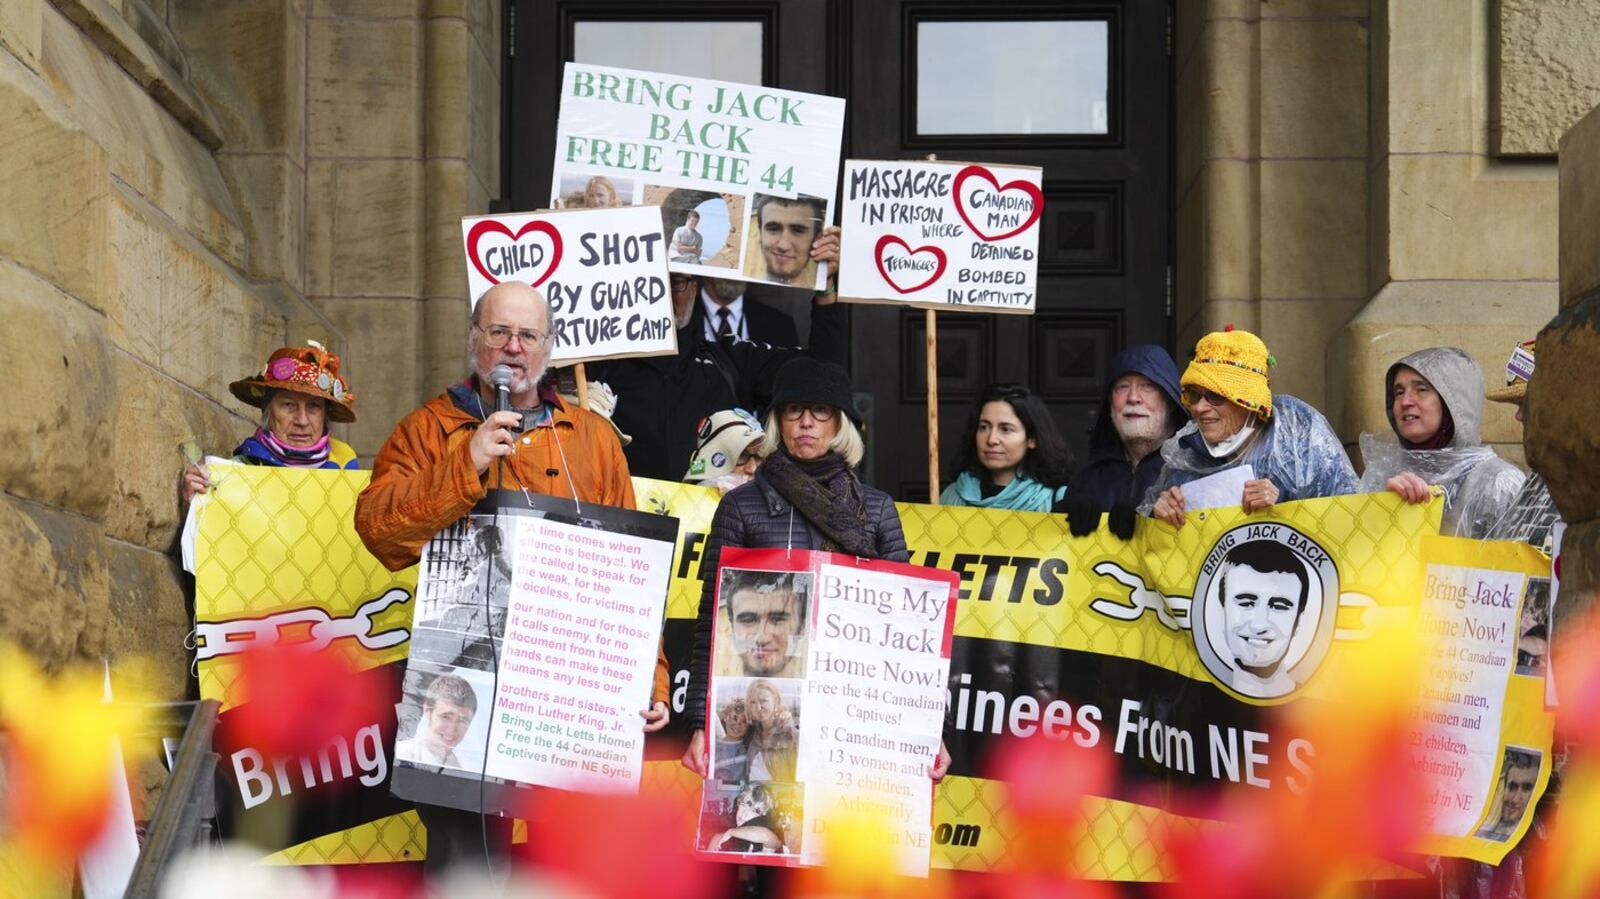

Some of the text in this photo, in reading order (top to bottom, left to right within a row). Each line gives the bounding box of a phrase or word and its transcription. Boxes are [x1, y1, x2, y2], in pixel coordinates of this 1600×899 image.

[573, 71, 804, 126] BRING JACK
[648, 113, 753, 153] BACK
[565, 135, 795, 192] FREE THE 44
[850, 167, 952, 200] MASSACRE
[861, 203, 943, 225] IN PRISON
[969, 189, 1035, 212] CANADIAN
[922, 224, 964, 238] WHERE
[987, 212, 1020, 228] MAN
[485, 232, 662, 276] CHILD SHOT
[884, 255, 936, 272] TEENAGERS
[971, 242, 1034, 260] DETAINED
[958, 269, 1026, 285] BOMBED
[547, 276, 665, 314] BY GUARD
[947, 289, 1033, 305] IN CAPTIVITY
[555, 313, 672, 348] RTURE CAMP
[520, 537, 650, 571] silence is betrayal. We
[540, 526, 565, 540] time
[568, 532, 605, 549] comes
[609, 540, 641, 555] when
[1203, 525, 1328, 576] BRING JACK BACK
[517, 565, 536, 577] the
[574, 577, 590, 590] for
[593, 580, 611, 594] the
[518, 553, 646, 586] are called to speak for
[575, 592, 592, 605] for
[595, 595, 635, 614] victims
[639, 606, 652, 617] of
[822, 574, 946, 621] Bring My
[1424, 574, 1514, 609] Bring Jack
[511, 615, 519, 626] it
[522, 617, 549, 632] calls
[596, 633, 611, 645] for
[614, 639, 629, 650] no
[514, 602, 650, 640] our nation and for those
[825, 613, 936, 654] Son Jack
[1463, 617, 1506, 644] Now!
[506, 644, 633, 682] hands can make these
[509, 630, 637, 667] document from human
[1459, 647, 1506, 667] Canadian
[504, 660, 622, 694] humans any less our
[814, 651, 941, 688] Home Now!
[501, 682, 550, 701] brothers
[553, 695, 575, 707] and
[808, 680, 944, 711] Free the 44 Canadian
[1463, 694, 1489, 711] men,
[498, 697, 535, 714] Martin
[537, 705, 576, 722] Luther
[611, 720, 625, 733] Jr.
[846, 703, 902, 726] Captives!
[955, 673, 1102, 748] inees
[1114, 699, 1195, 775] From
[1208, 724, 1271, 789] NE
[1422, 709, 1459, 727] women
[1462, 715, 1482, 730] and
[500, 713, 635, 750] Bring Jack Letts Home!
[505, 729, 628, 763] Free the 44 Canadian
[820, 726, 934, 758] 8 Canadian men,
[231, 723, 387, 810] Bring
[497, 743, 632, 779] Captives from NE Syria
[829, 748, 924, 777] 13 women and
[836, 771, 914, 797] 23 children.
[1453, 793, 1473, 811] NE
[904, 829, 928, 848] NE
